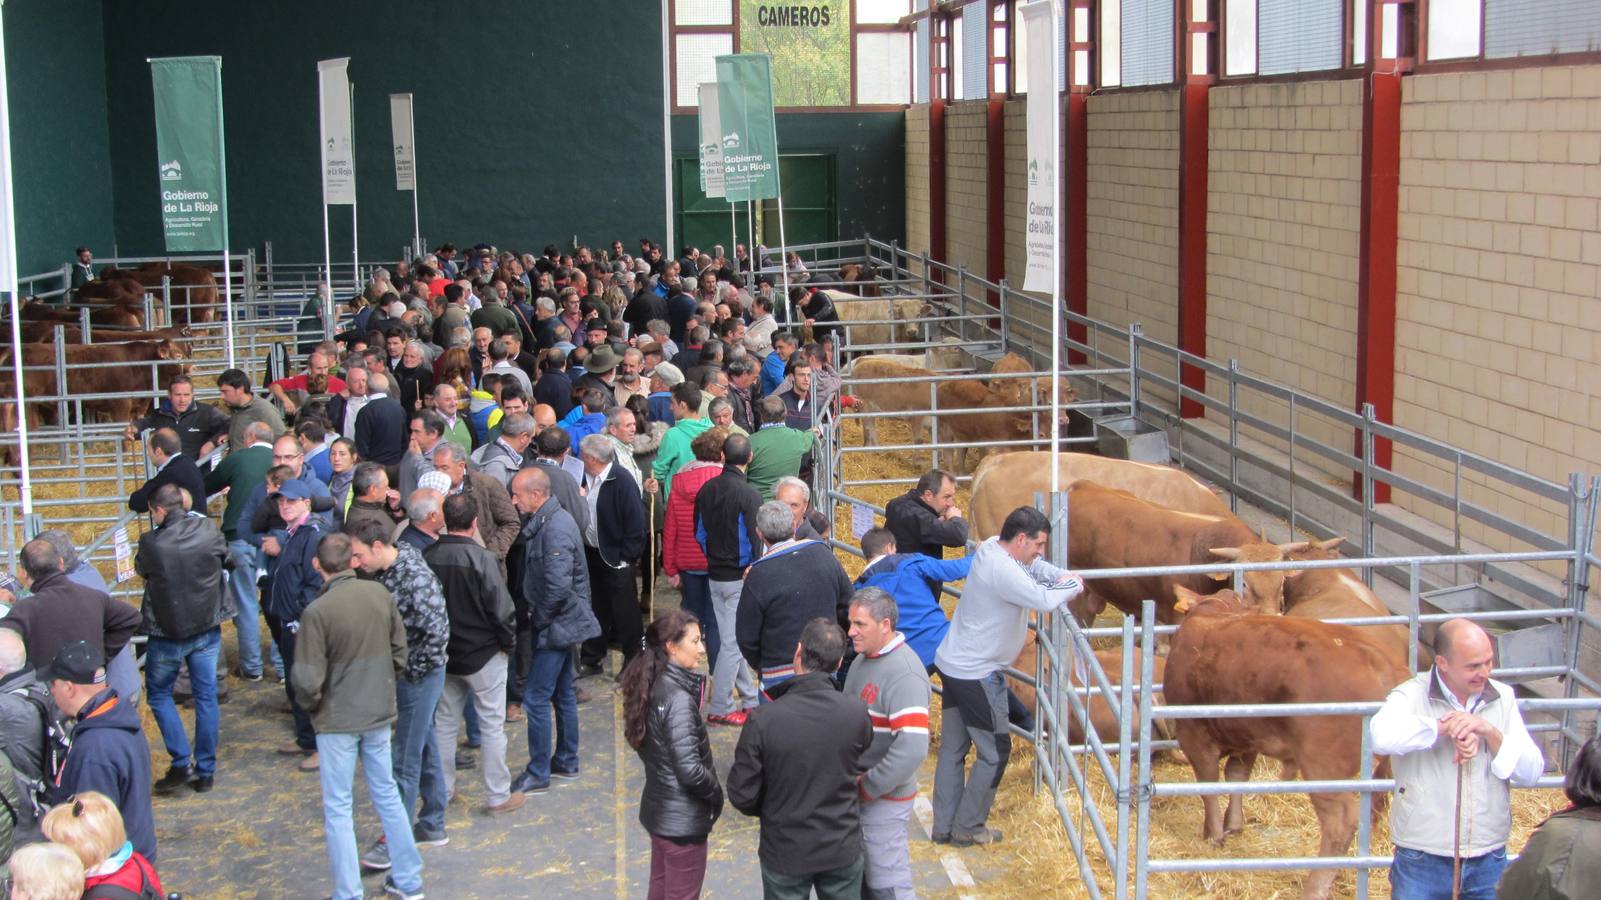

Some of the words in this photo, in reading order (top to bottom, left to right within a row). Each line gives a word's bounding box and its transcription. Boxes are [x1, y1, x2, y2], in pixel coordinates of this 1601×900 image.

[758, 5, 830, 27] CAMEROS
[725, 155, 762, 163] Gobierno
[725, 165, 735, 173] de
[737, 164, 748, 172] La
[750, 162, 771, 171] Rioja
[163, 190, 209, 200] Gobierno
[164, 202, 177, 213] de
[180, 202, 193, 212] La
[194, 202, 218, 213] Rioja
